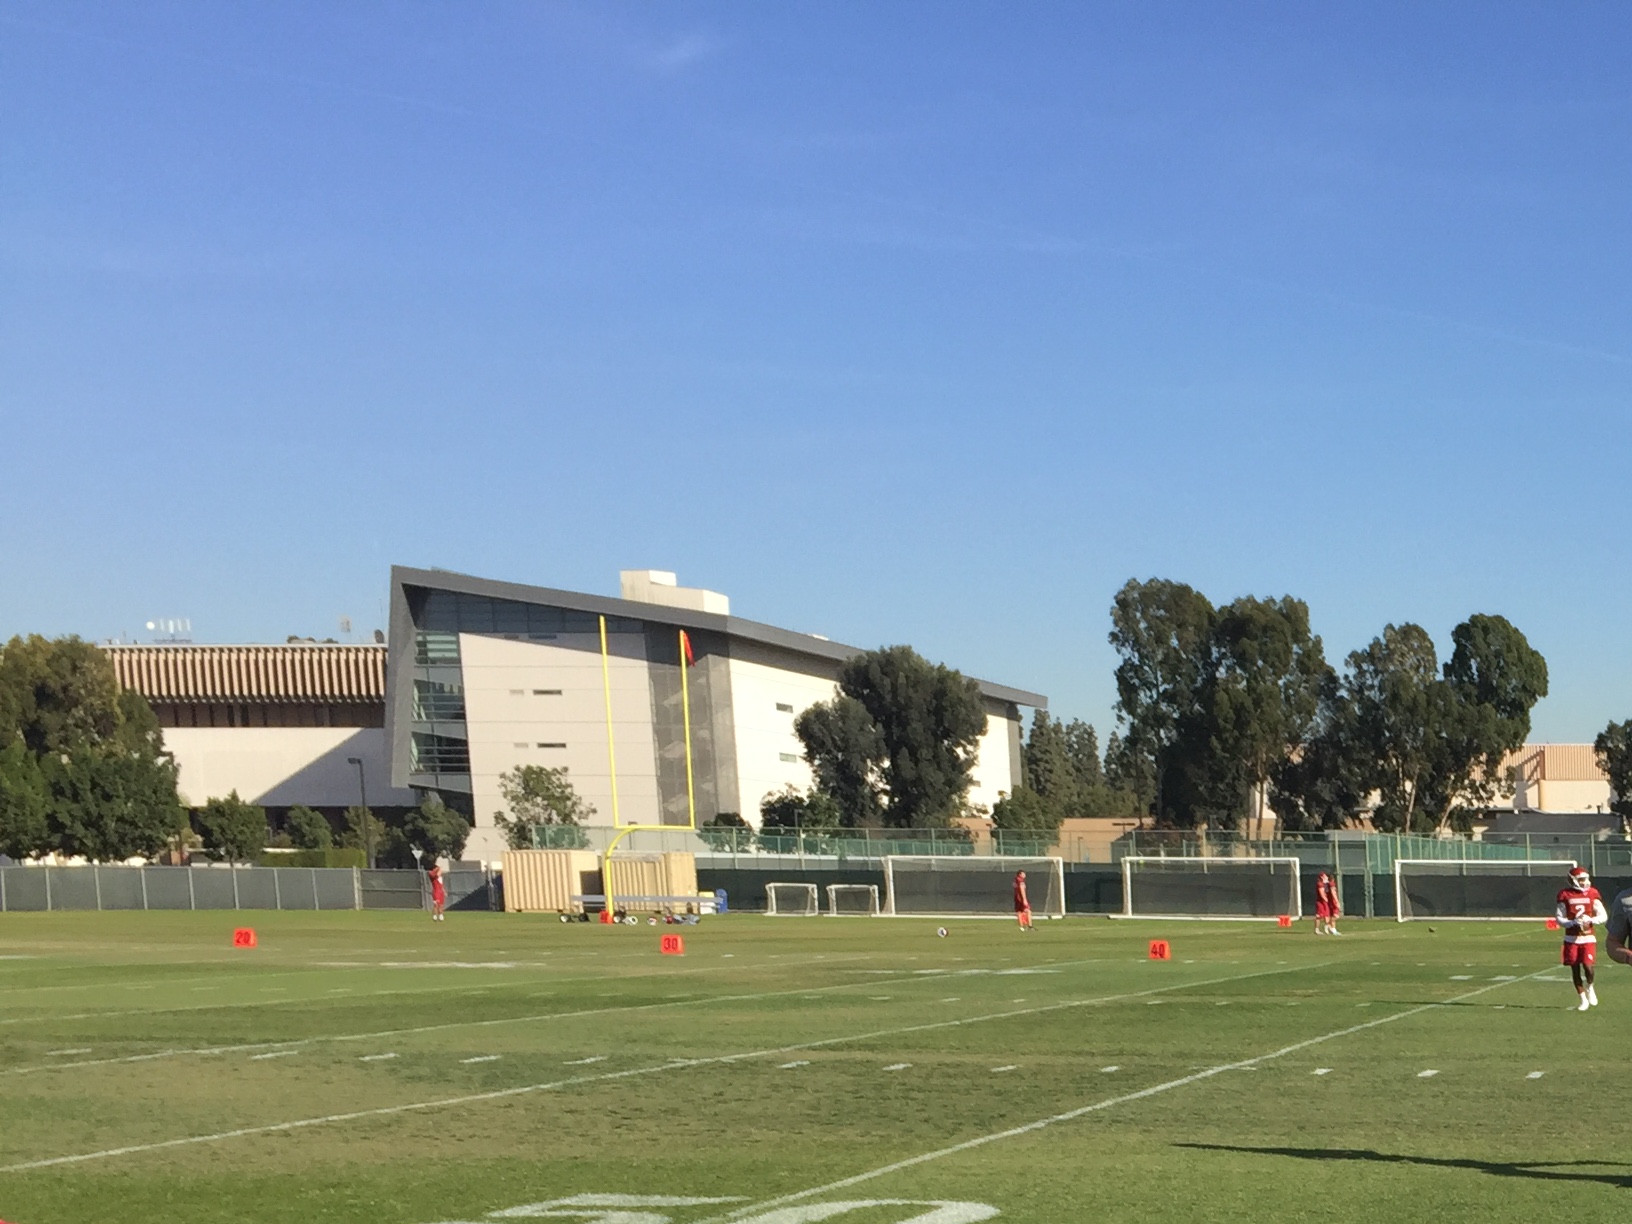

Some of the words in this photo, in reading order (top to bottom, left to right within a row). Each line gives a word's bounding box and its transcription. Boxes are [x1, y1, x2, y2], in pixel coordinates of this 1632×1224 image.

[235, 931, 251, 944] 20
[663, 937, 679, 951] 30
[1150, 943, 1166, 959] 40
